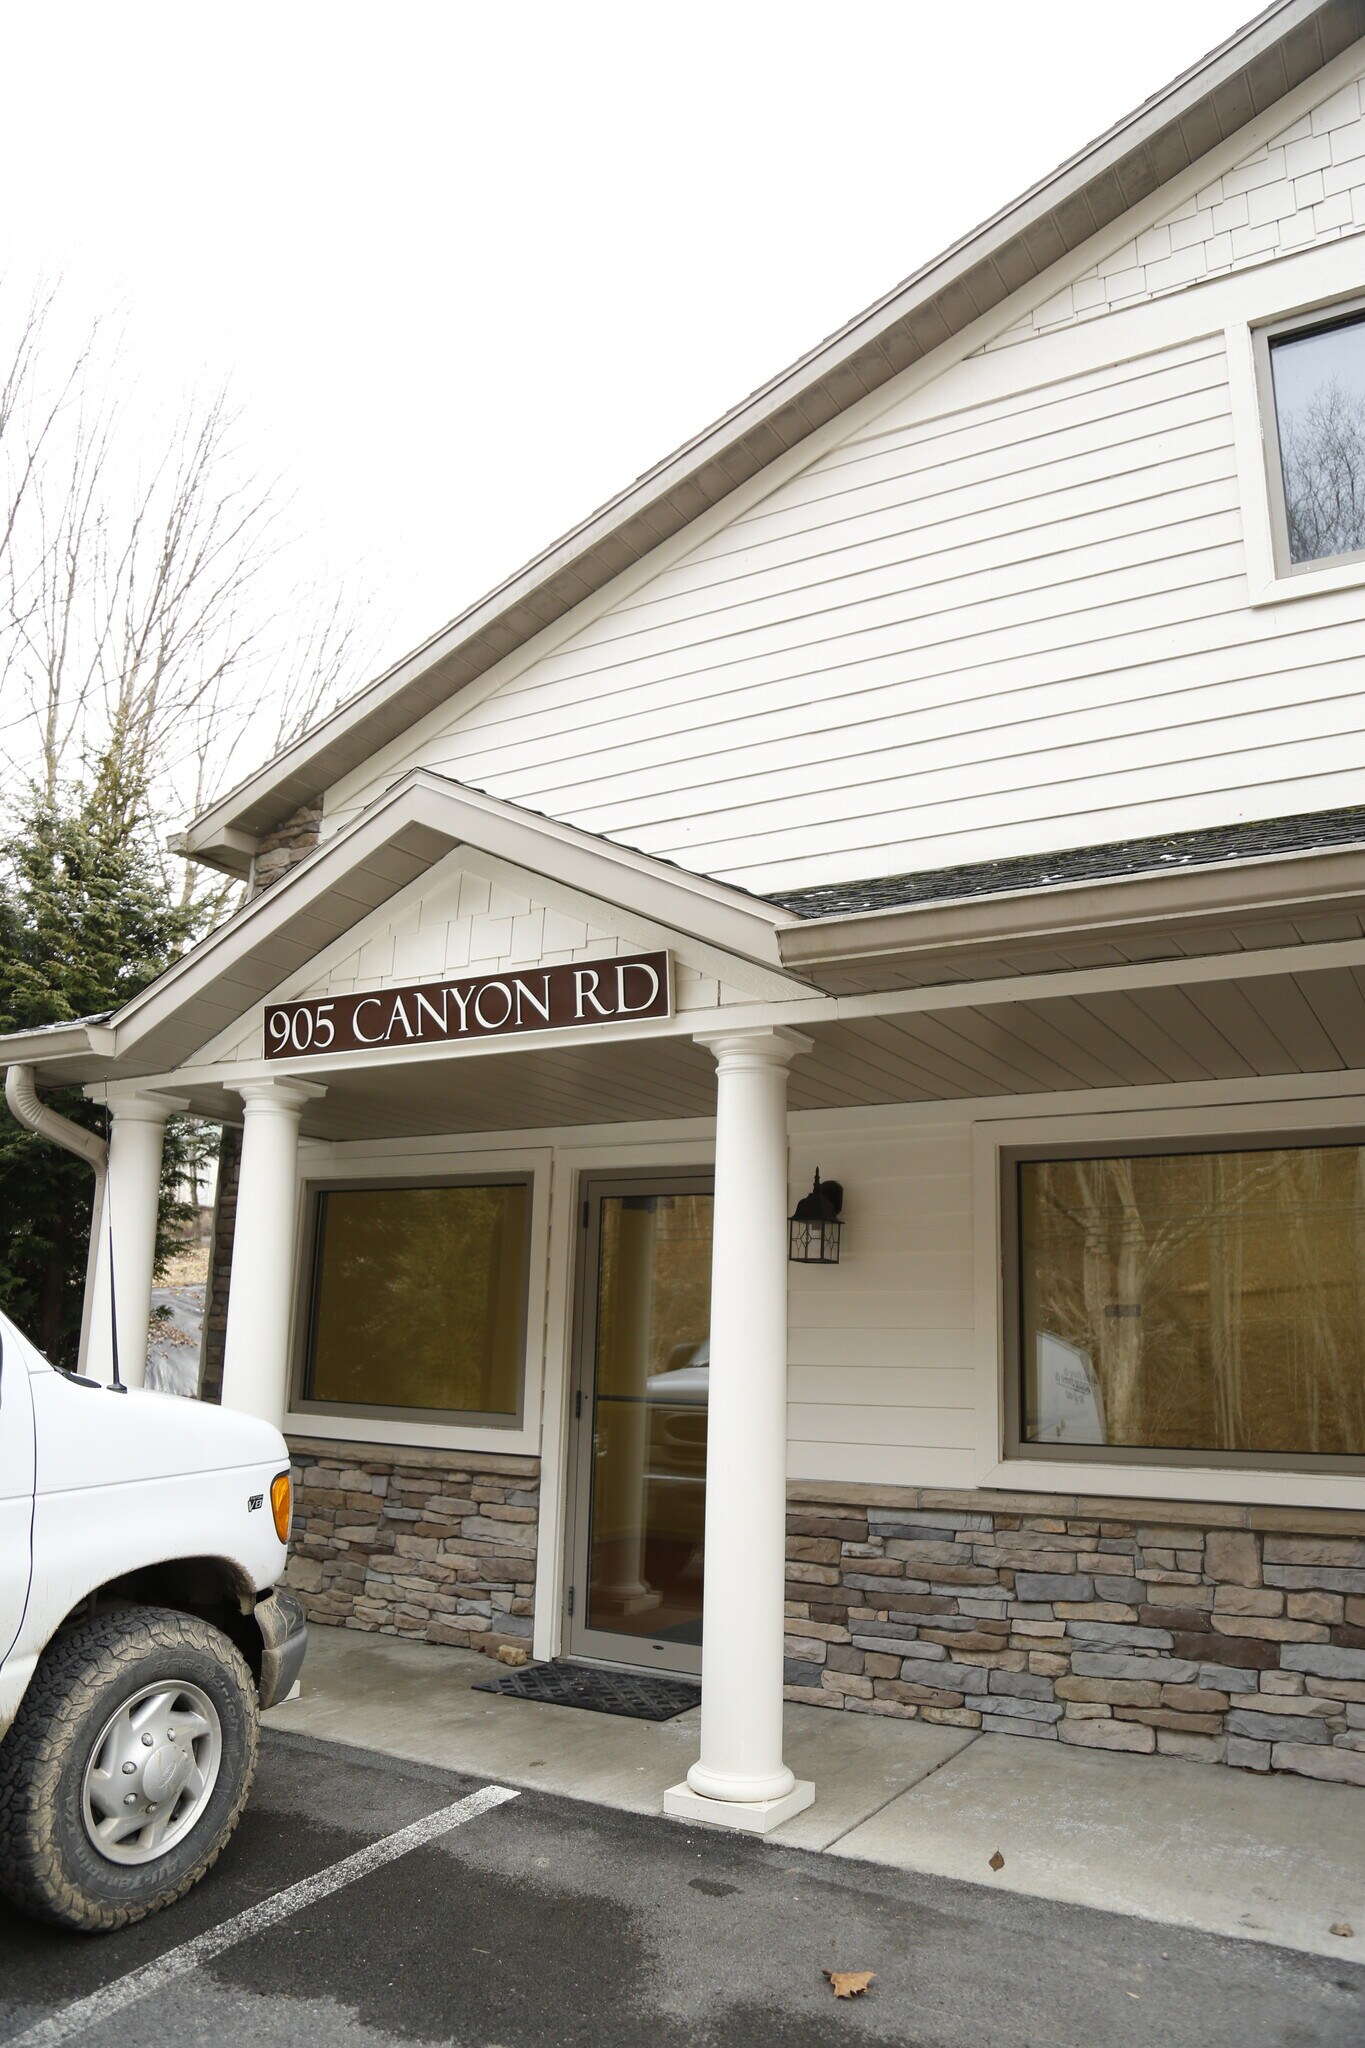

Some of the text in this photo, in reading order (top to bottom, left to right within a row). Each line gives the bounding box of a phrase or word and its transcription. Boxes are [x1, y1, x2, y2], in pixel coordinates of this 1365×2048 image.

[269, 963, 660, 1053] 905 CANYON RD
[247, 1499, 262, 1512] V8
